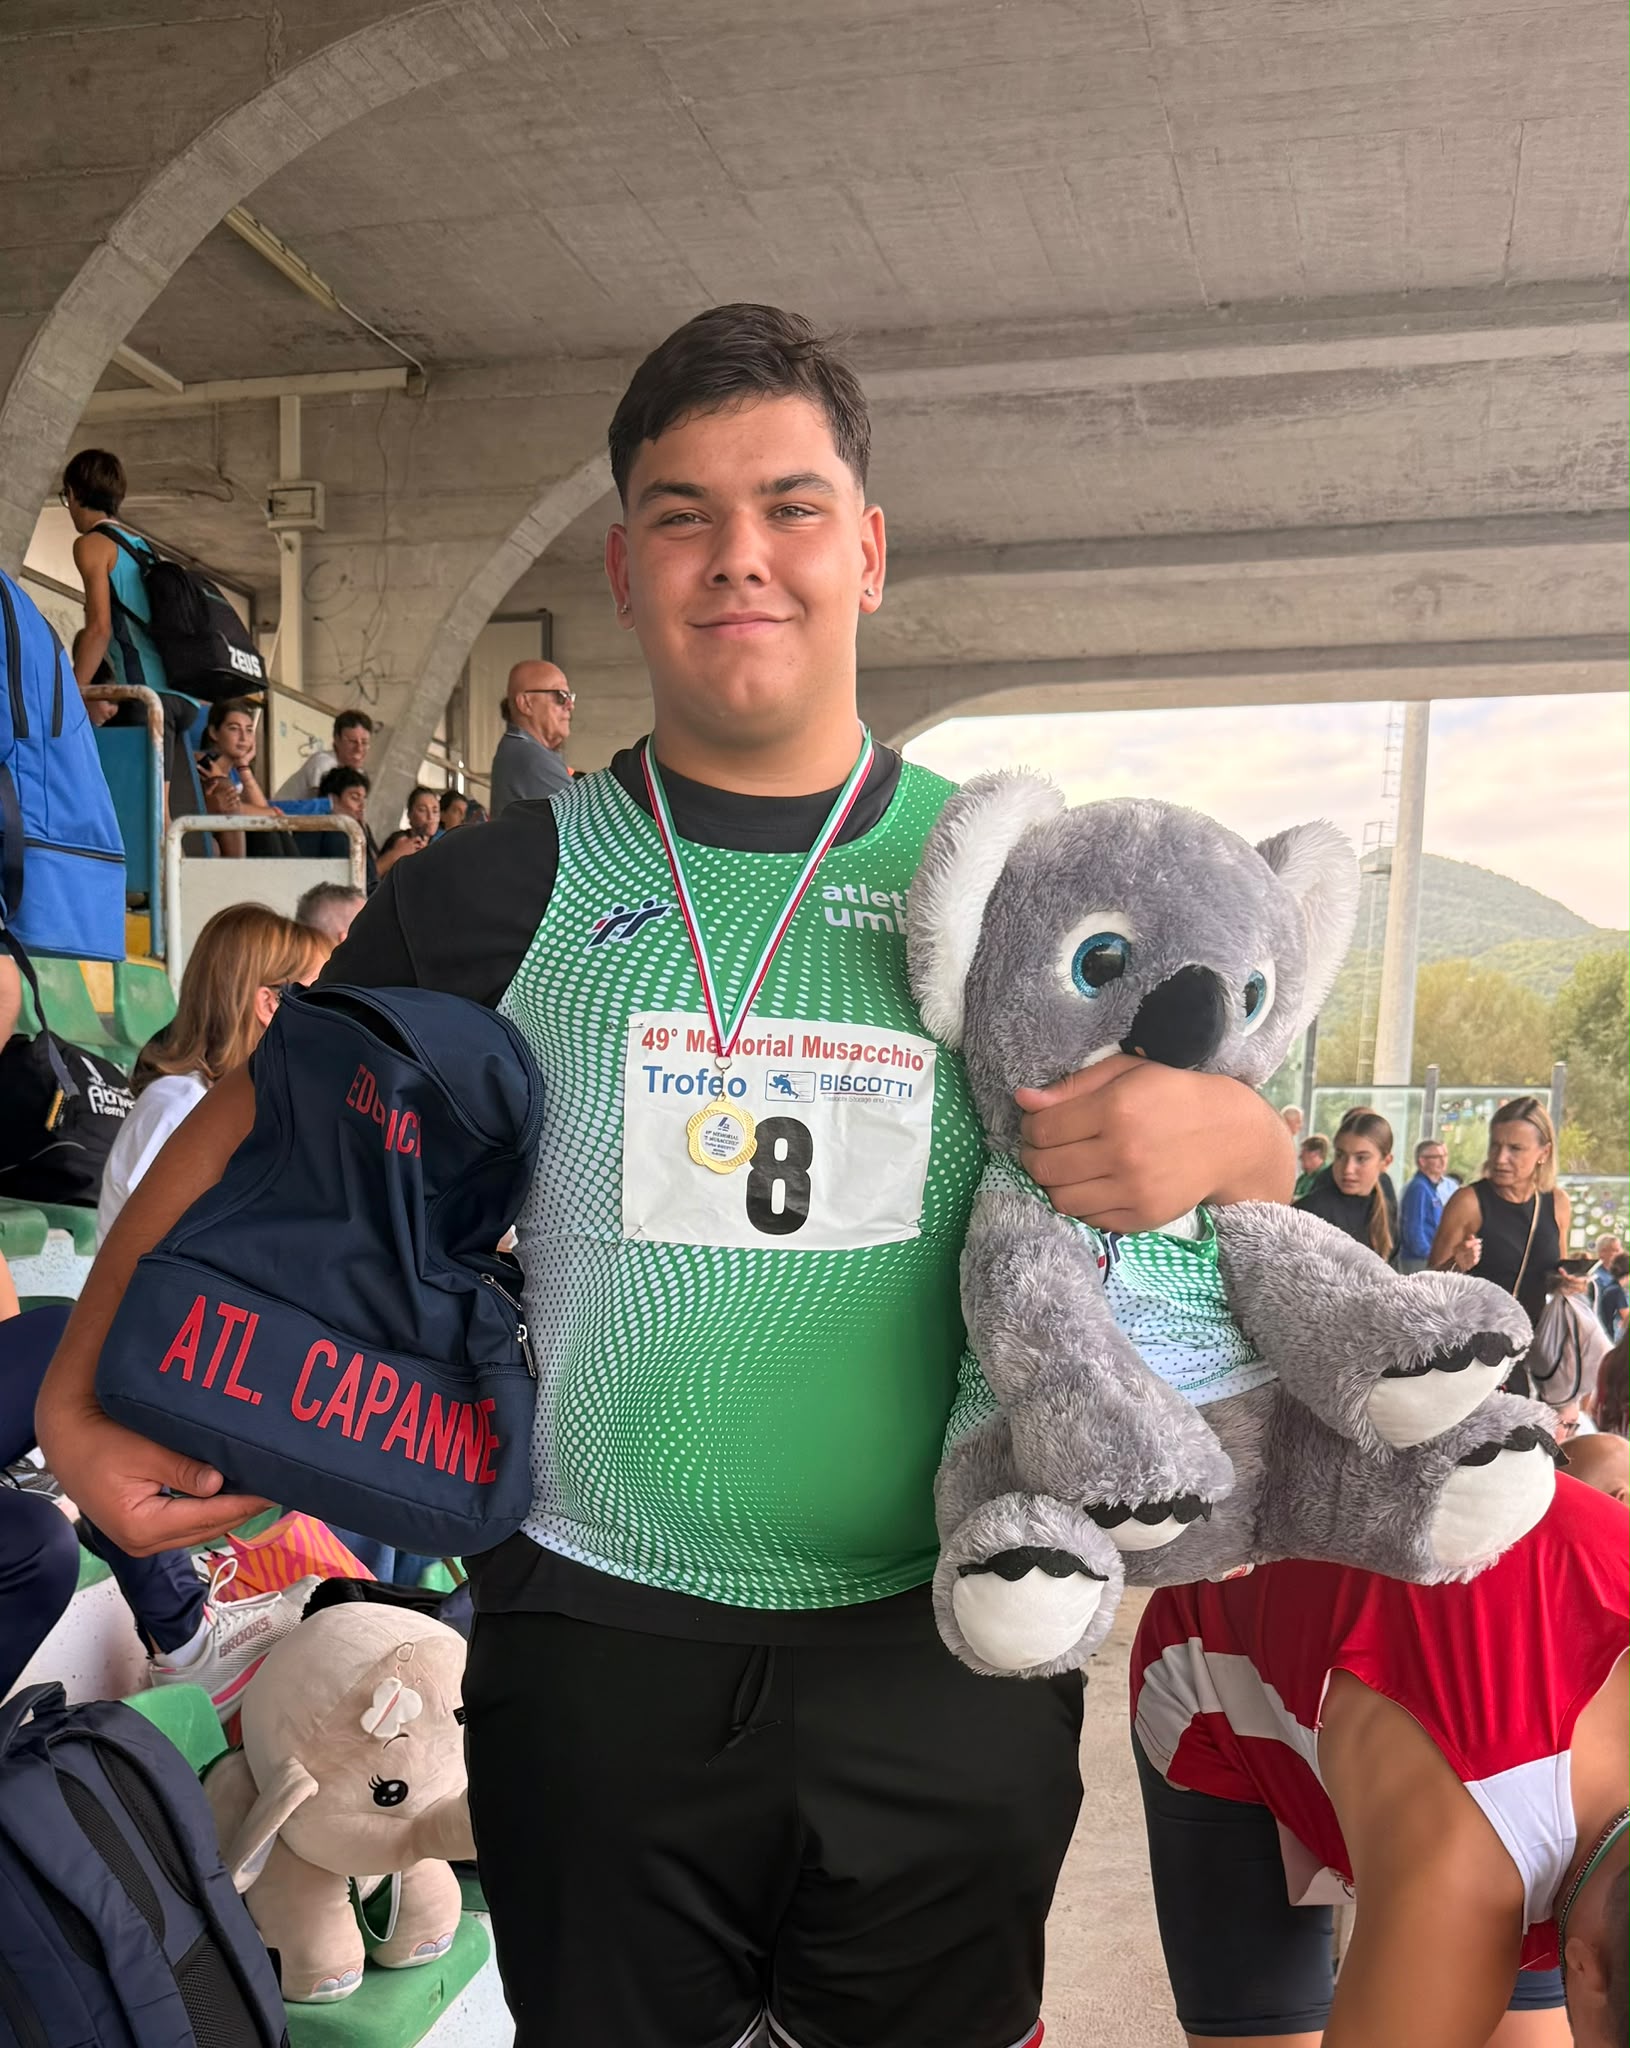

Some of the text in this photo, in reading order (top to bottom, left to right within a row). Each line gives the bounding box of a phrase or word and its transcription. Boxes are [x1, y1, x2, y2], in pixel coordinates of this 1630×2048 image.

[228, 645, 263, 679] ZEUS
[641, 1027, 924, 1071] 49° Meorial Musacchio
[642, 1066, 912, 1098] Trofeo BISCOTTI
[746, 1116, 814, 1236] 8
[159, 1294, 499, 1484] ATL. CAPANNE
[219, 1615, 272, 1658] BROOKS
